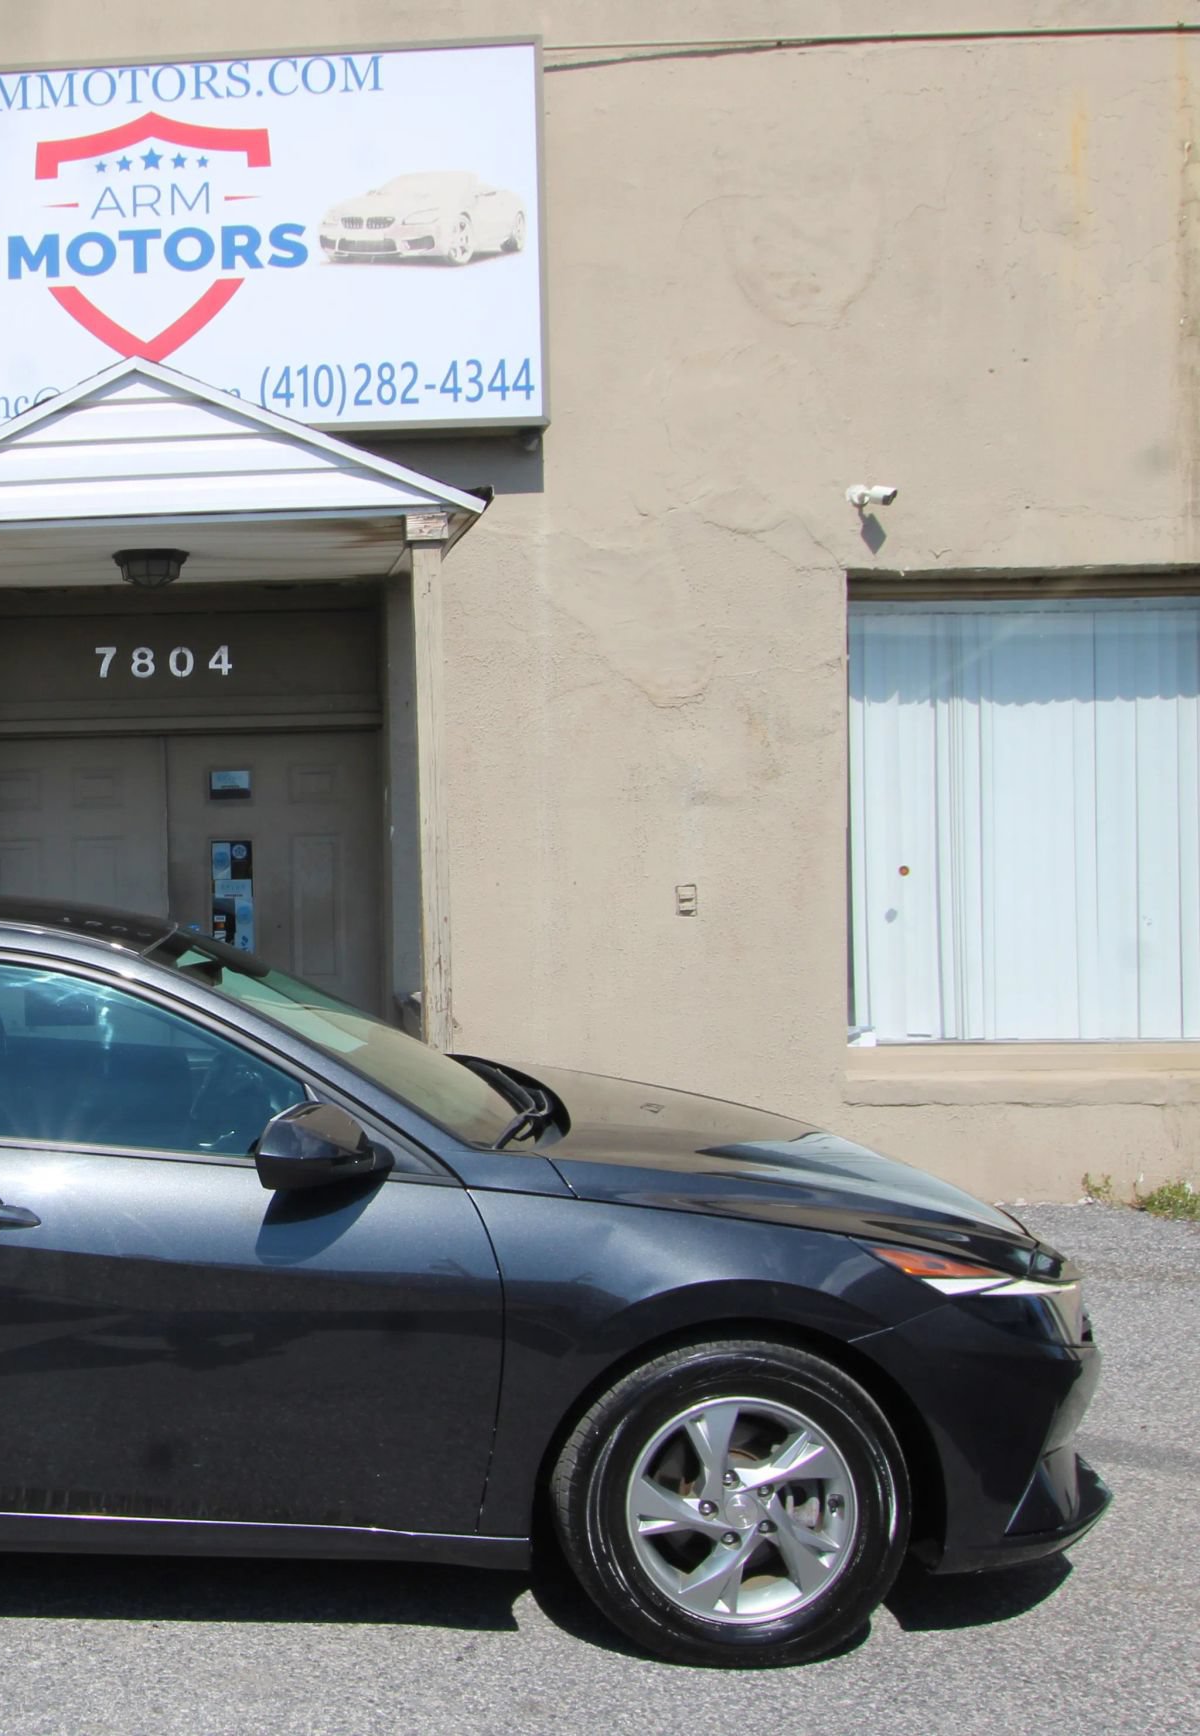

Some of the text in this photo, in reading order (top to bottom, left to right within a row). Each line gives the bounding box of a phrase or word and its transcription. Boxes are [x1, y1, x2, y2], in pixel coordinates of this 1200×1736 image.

[90, 182, 211, 220] ARM
[7, 222, 309, 280] MOTORS
[260, 357, 535, 416] (410)282-4344
[95, 645, 233, 678] 7804
